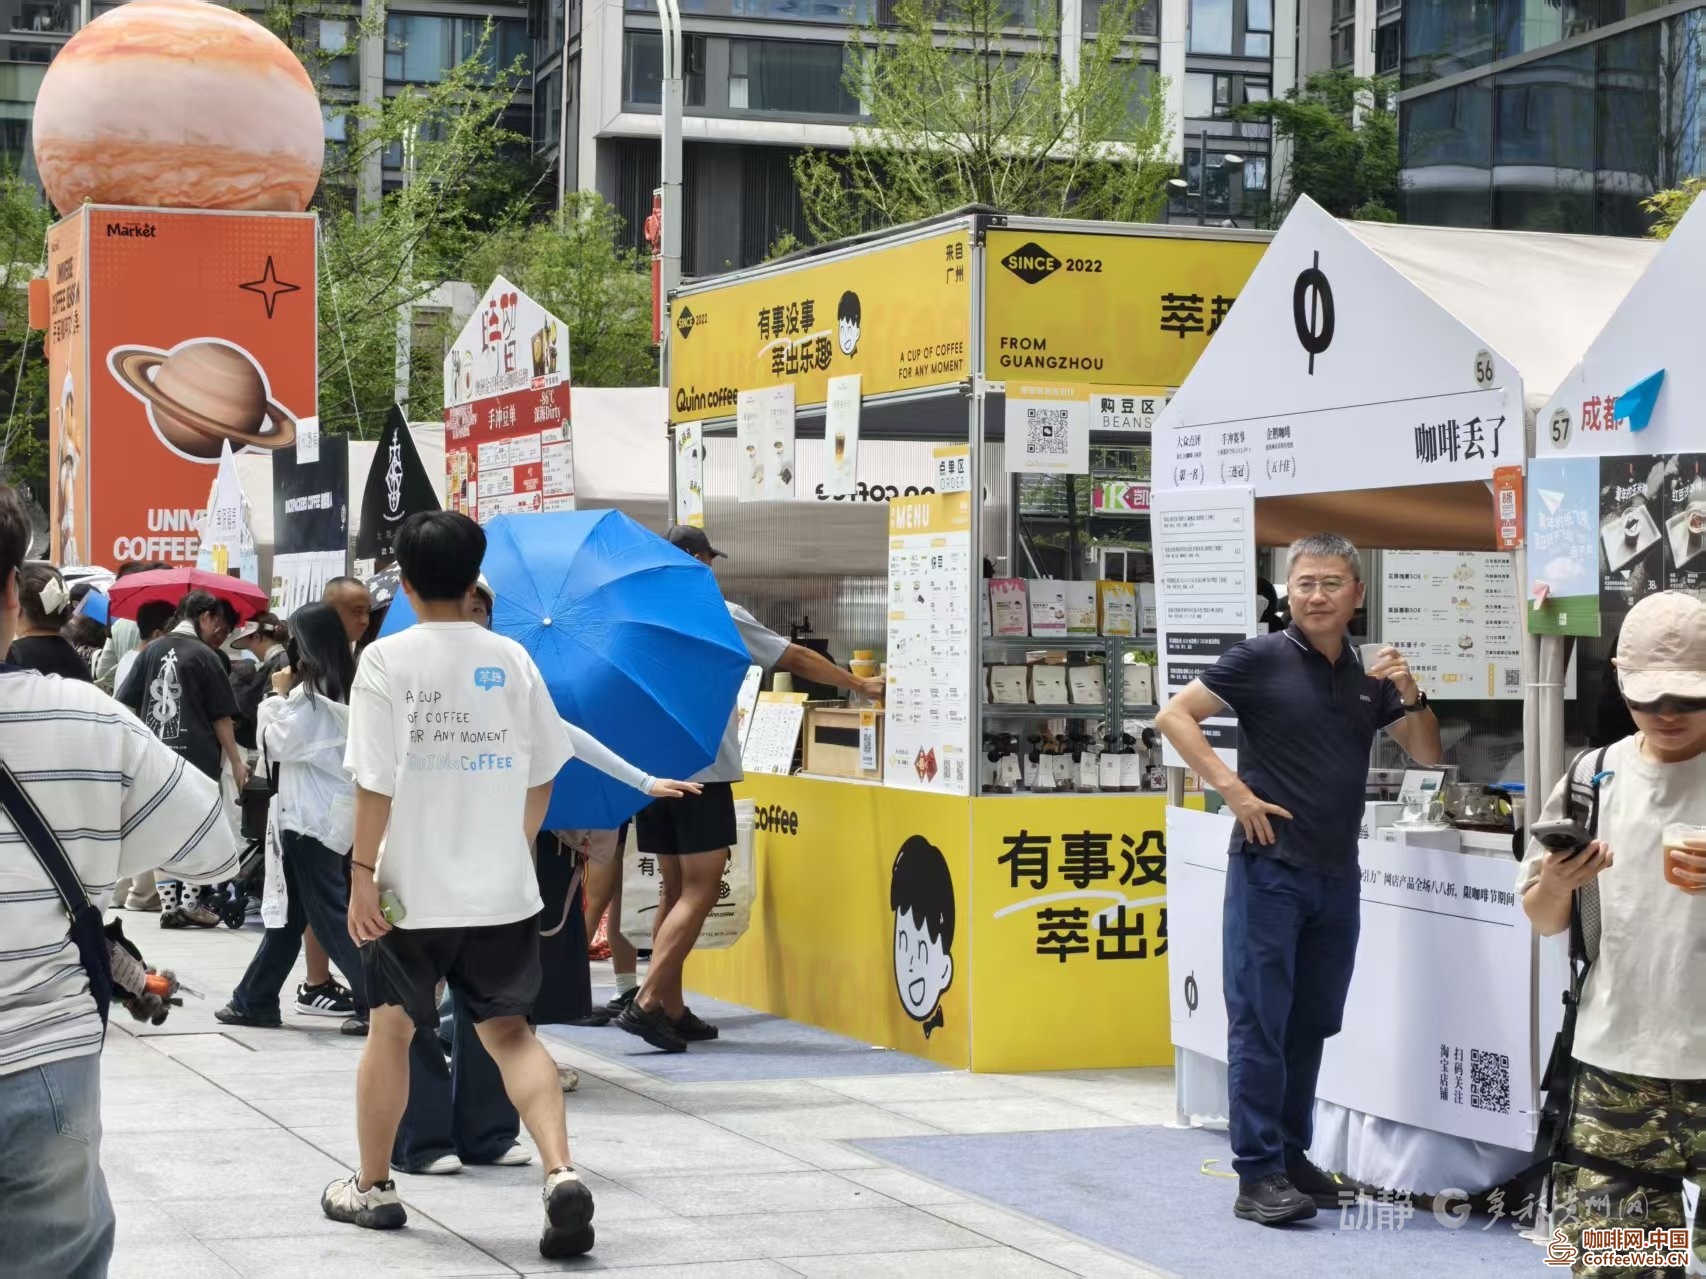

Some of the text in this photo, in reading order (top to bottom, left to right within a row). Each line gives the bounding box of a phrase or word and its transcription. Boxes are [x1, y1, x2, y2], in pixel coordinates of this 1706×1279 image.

[106, 223, 156, 238] Market
[945, 242, 963, 262] 来自
[1008, 255, 1103, 273] SINCE 2022
[946, 265, 964, 285] 广州
[677, 313, 709, 329] SINCE 2022
[757, 298, 816, 341] 有事没事
[900, 341, 964, 363] A CUP OF COFFEE
[1000, 336, 1047, 351] FROM
[771, 336, 833, 378] 萃出乐趣
[1000, 354, 1104, 371] GUANGZHOU
[898, 358, 963, 380] FOR ANY MOMENT
[1476, 359, 1493, 383] 56
[675, 386, 707, 413] Quinn
[707, 387, 738, 408] coffee
[1100, 397, 1155, 415] 购豆区
[1103, 416, 1152, 429] BEANS
[1552, 417, 1570, 442] 57
[1414, 415, 1506, 464] 咖啡丢了
[940, 475, 965, 490] ORDER
[113, 536, 199, 561] COFFEE
[405, 690, 442, 704] A CUP
[407, 711, 471, 724] OF COFFEE
[433, 729, 455, 743] ANY
[755, 804, 799, 835] coffee
[997, 829, 1168, 889] 有事没
[1440, 1043, 1449, 1101] 淘宝店铺
[1454, 1046, 1463, 1104] 扫码关注
